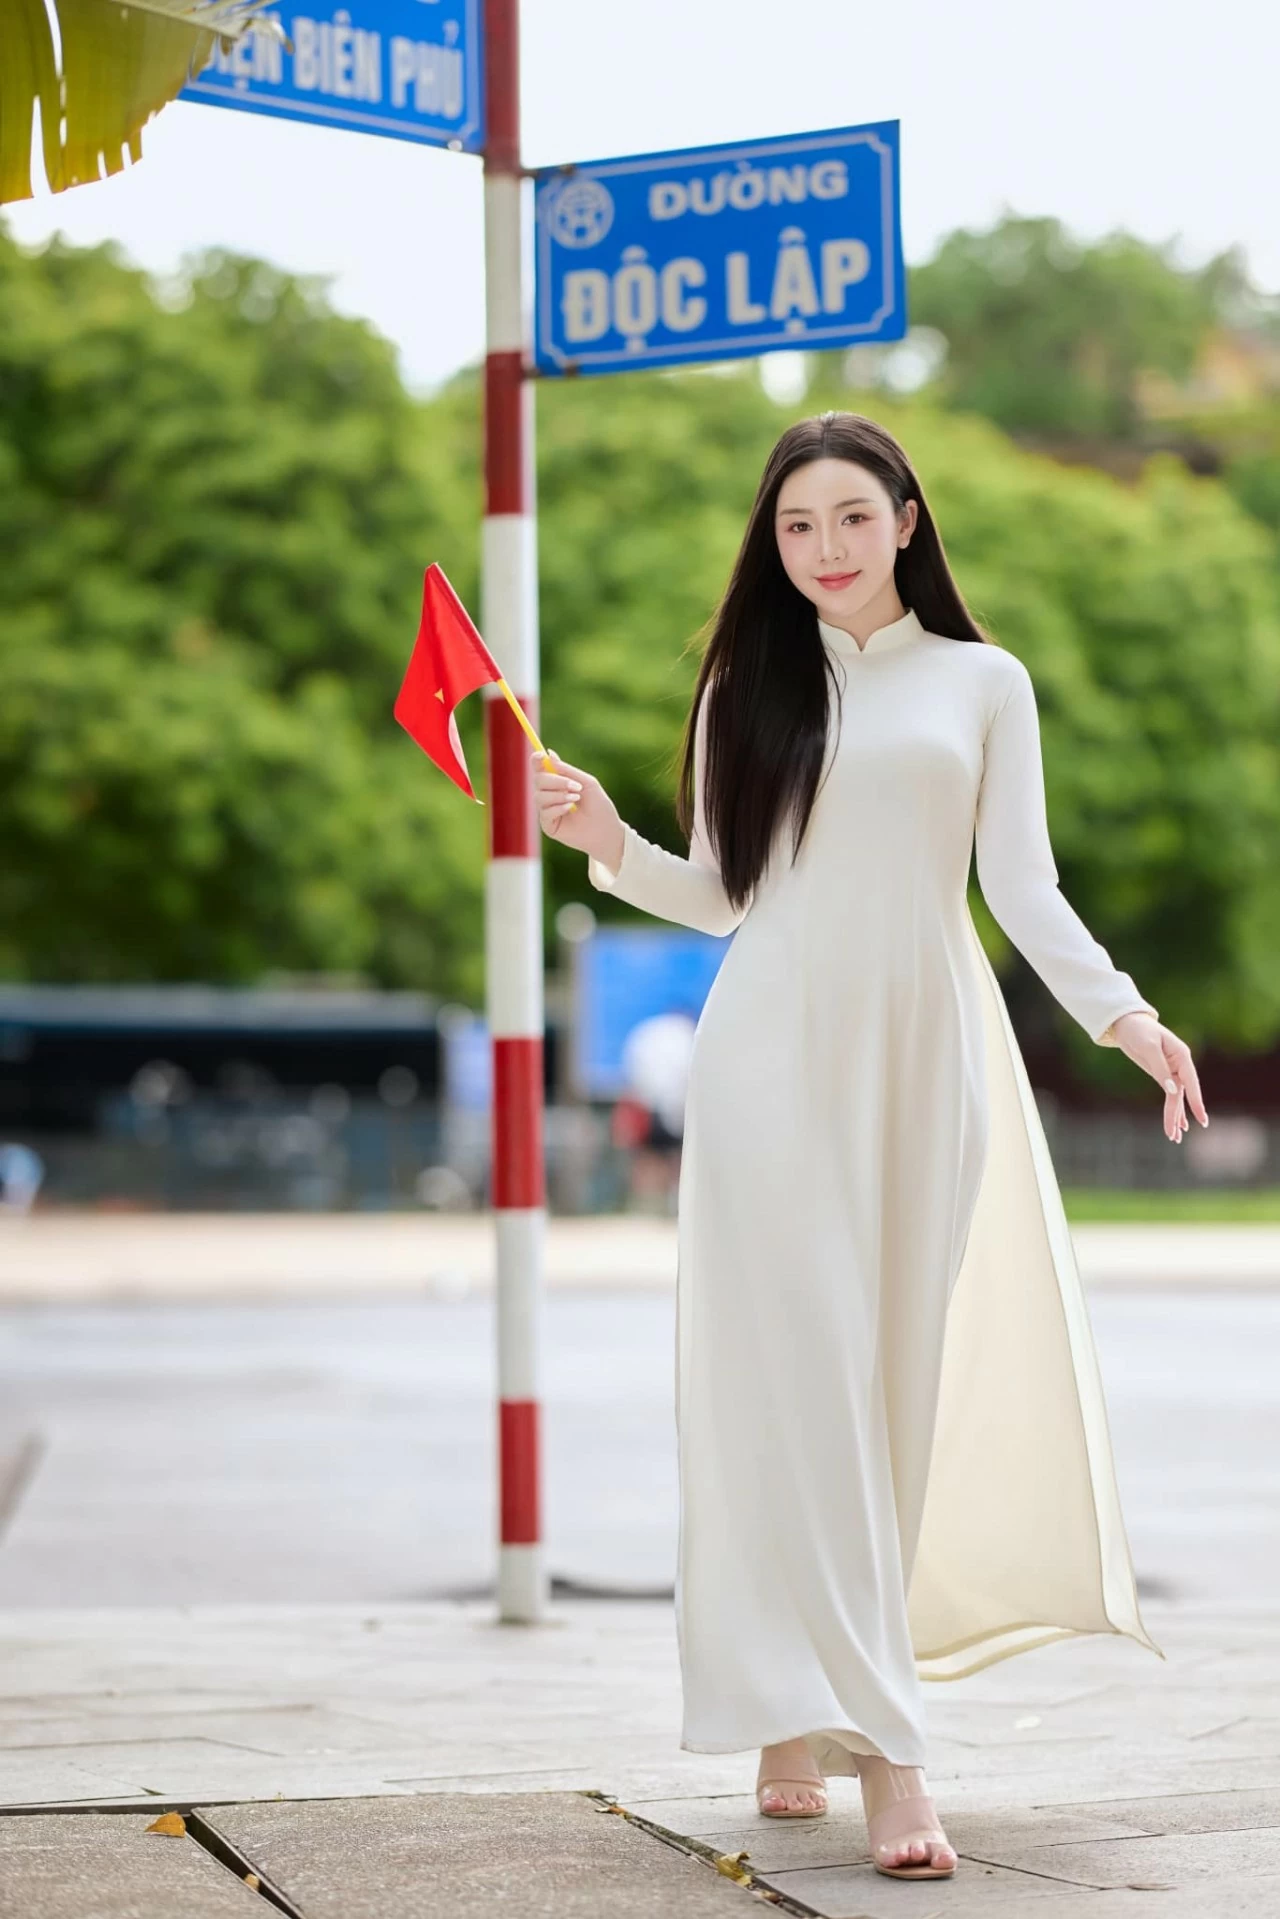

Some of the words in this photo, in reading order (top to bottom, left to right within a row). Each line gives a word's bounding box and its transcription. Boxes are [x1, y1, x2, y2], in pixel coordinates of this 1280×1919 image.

[291, 9, 382, 104] BIÊN
[391, 19, 463, 119] PHỦ
[561, 245, 707, 354] ĐỘC
[725, 227, 870, 335] LẬP
